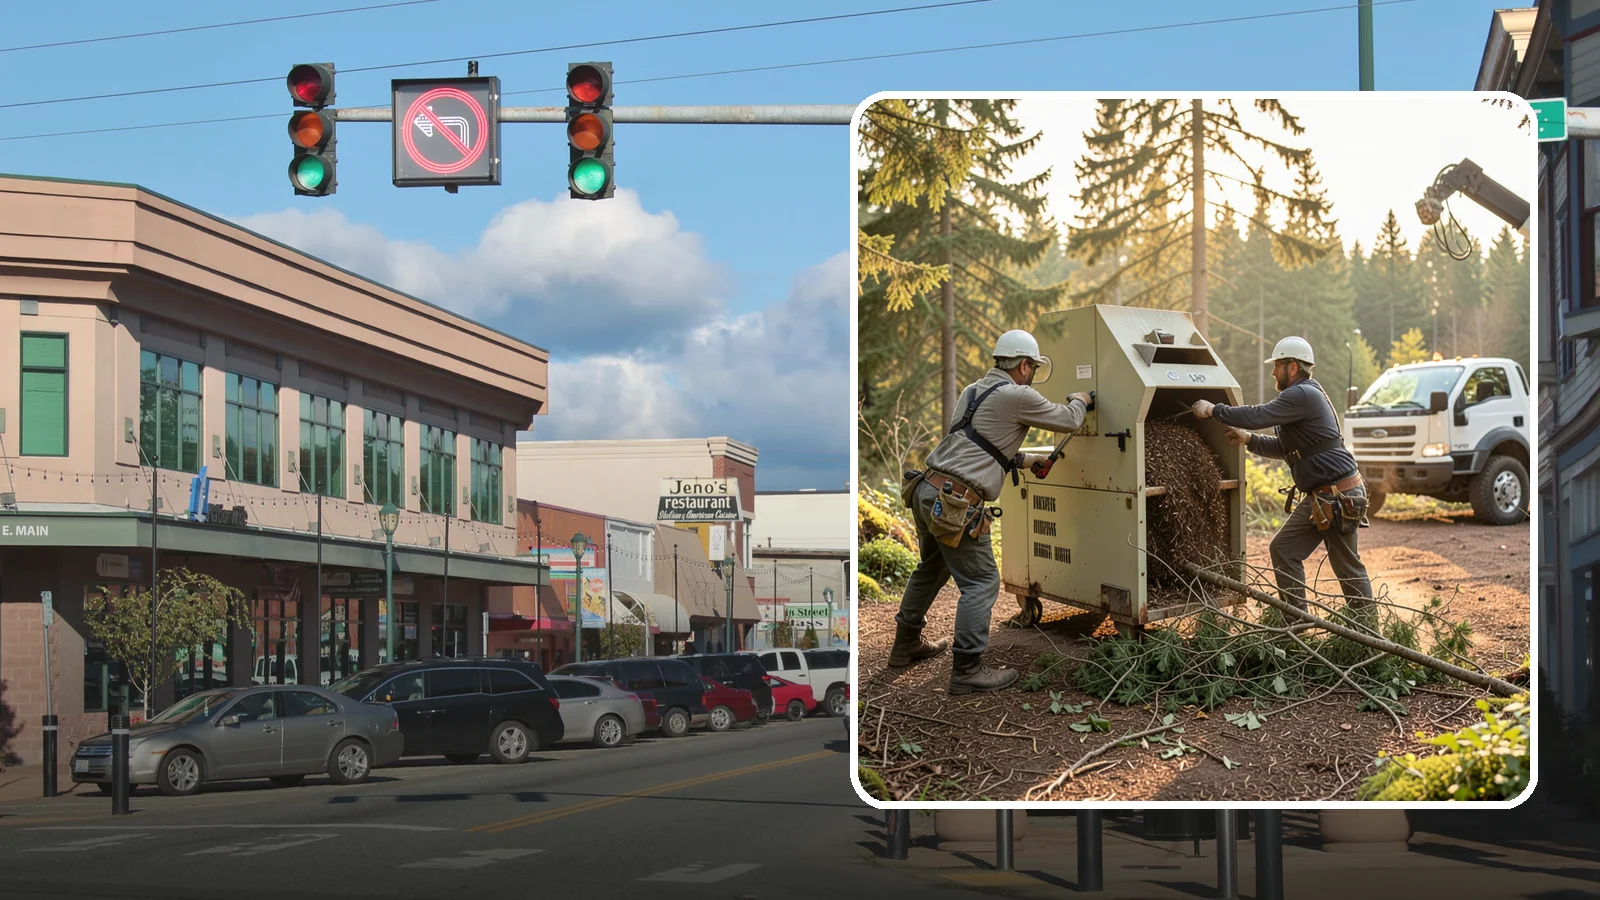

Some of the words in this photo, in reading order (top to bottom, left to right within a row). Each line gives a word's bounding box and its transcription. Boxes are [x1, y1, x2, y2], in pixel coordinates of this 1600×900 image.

[670, 480, 727, 494] Jeno's
[665, 496, 731, 509] restaurant
[659, 509, 681, 519] Italian
[686, 509, 714, 519] American
[715, 509, 737, 519] Cuisine
[2, 525, 13, 536] E.
[15, 525, 49, 536] MAIN
[797, 607, 828, 616] Street
[790, 619, 824, 627] lass
